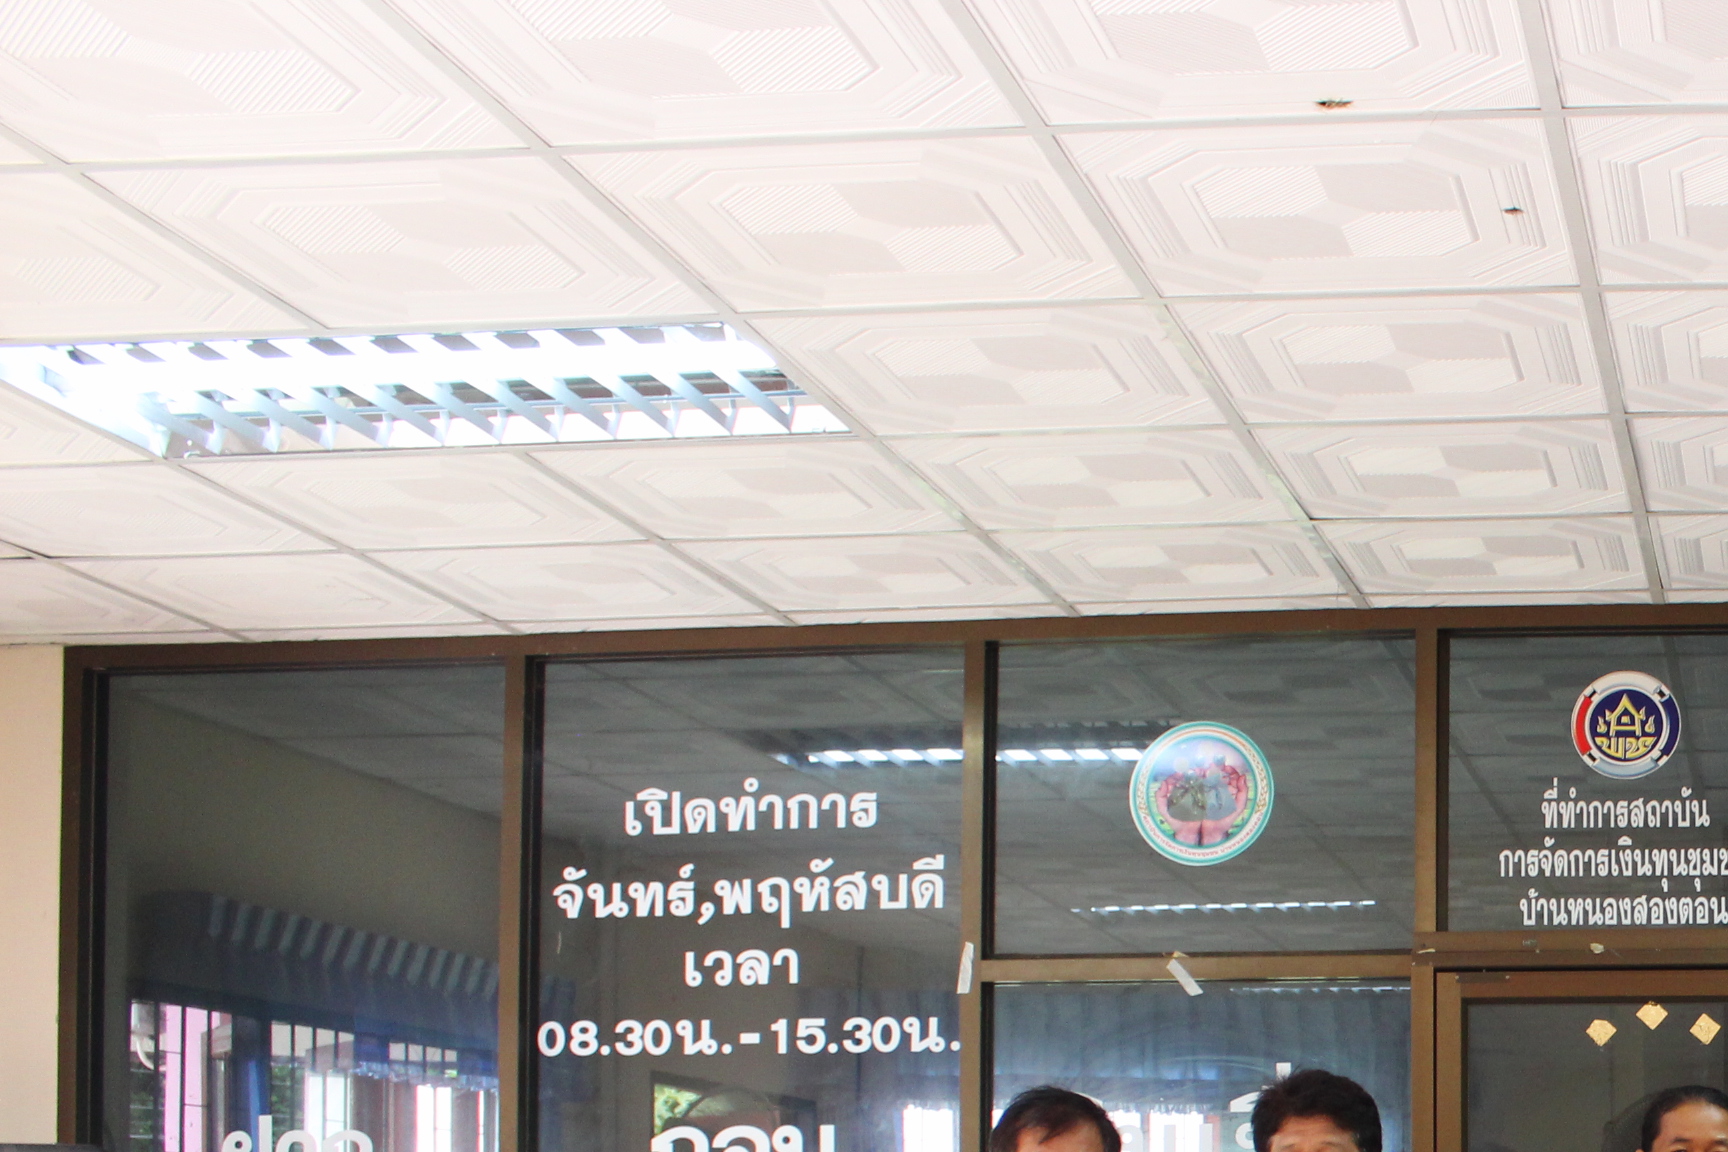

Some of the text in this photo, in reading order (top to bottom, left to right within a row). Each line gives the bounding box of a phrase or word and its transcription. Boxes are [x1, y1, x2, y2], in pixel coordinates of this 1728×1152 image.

[625, 778, 877, 836] เปิดทำการ
[1541, 777, 1710, 828] ที่ทำการสถาบัน
[553, 855, 945, 928] จันทร์,พฤหัสบดี
[1520, 888, 1728, 926] บ้านหนองสองตอน
[685, 948, 798, 987] เวลา
